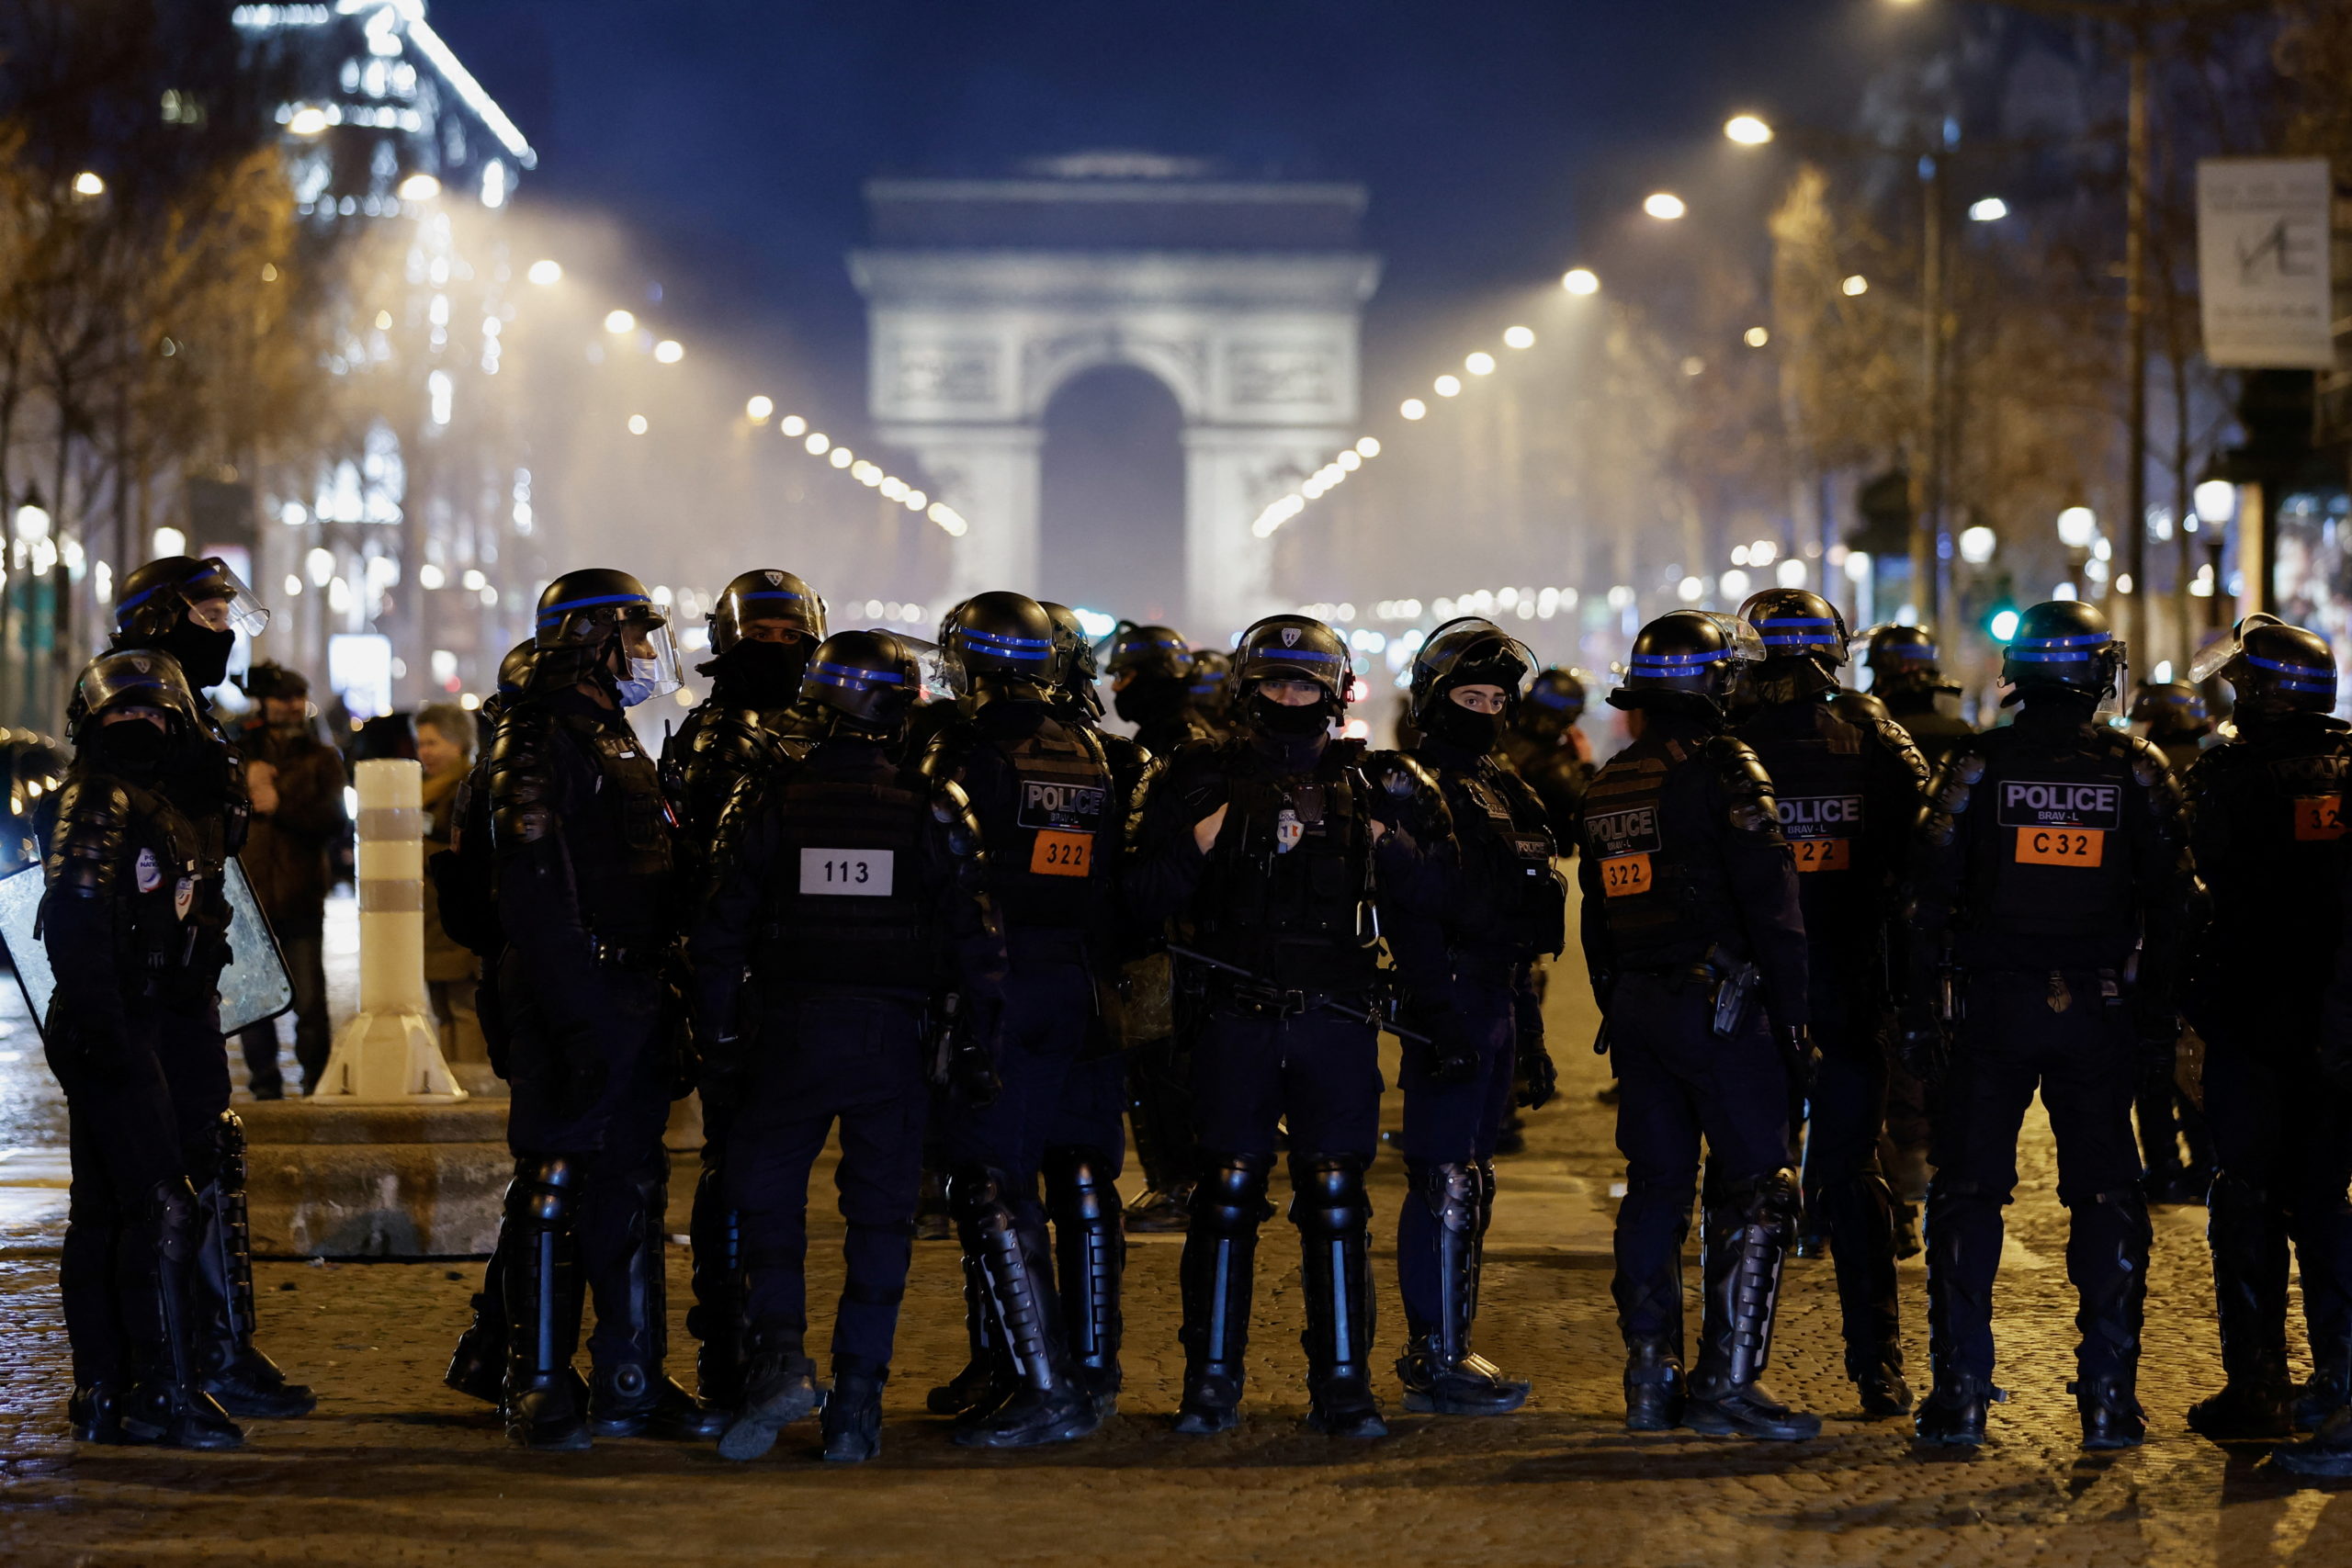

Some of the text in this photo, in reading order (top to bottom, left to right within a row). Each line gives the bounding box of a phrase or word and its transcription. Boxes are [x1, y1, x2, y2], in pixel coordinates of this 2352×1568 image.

[1027, 784, 1102, 816] POLICE
[2007, 784, 2115, 812] POLICE
[1777, 798, 1860, 825] OLICE
[1587, 810, 1655, 844] POLICE
[1046, 843, 1082, 865] 322
[2034, 832, 2087, 855] C32
[824, 861, 868, 883] 113
[1610, 863, 1641, 886] 322
